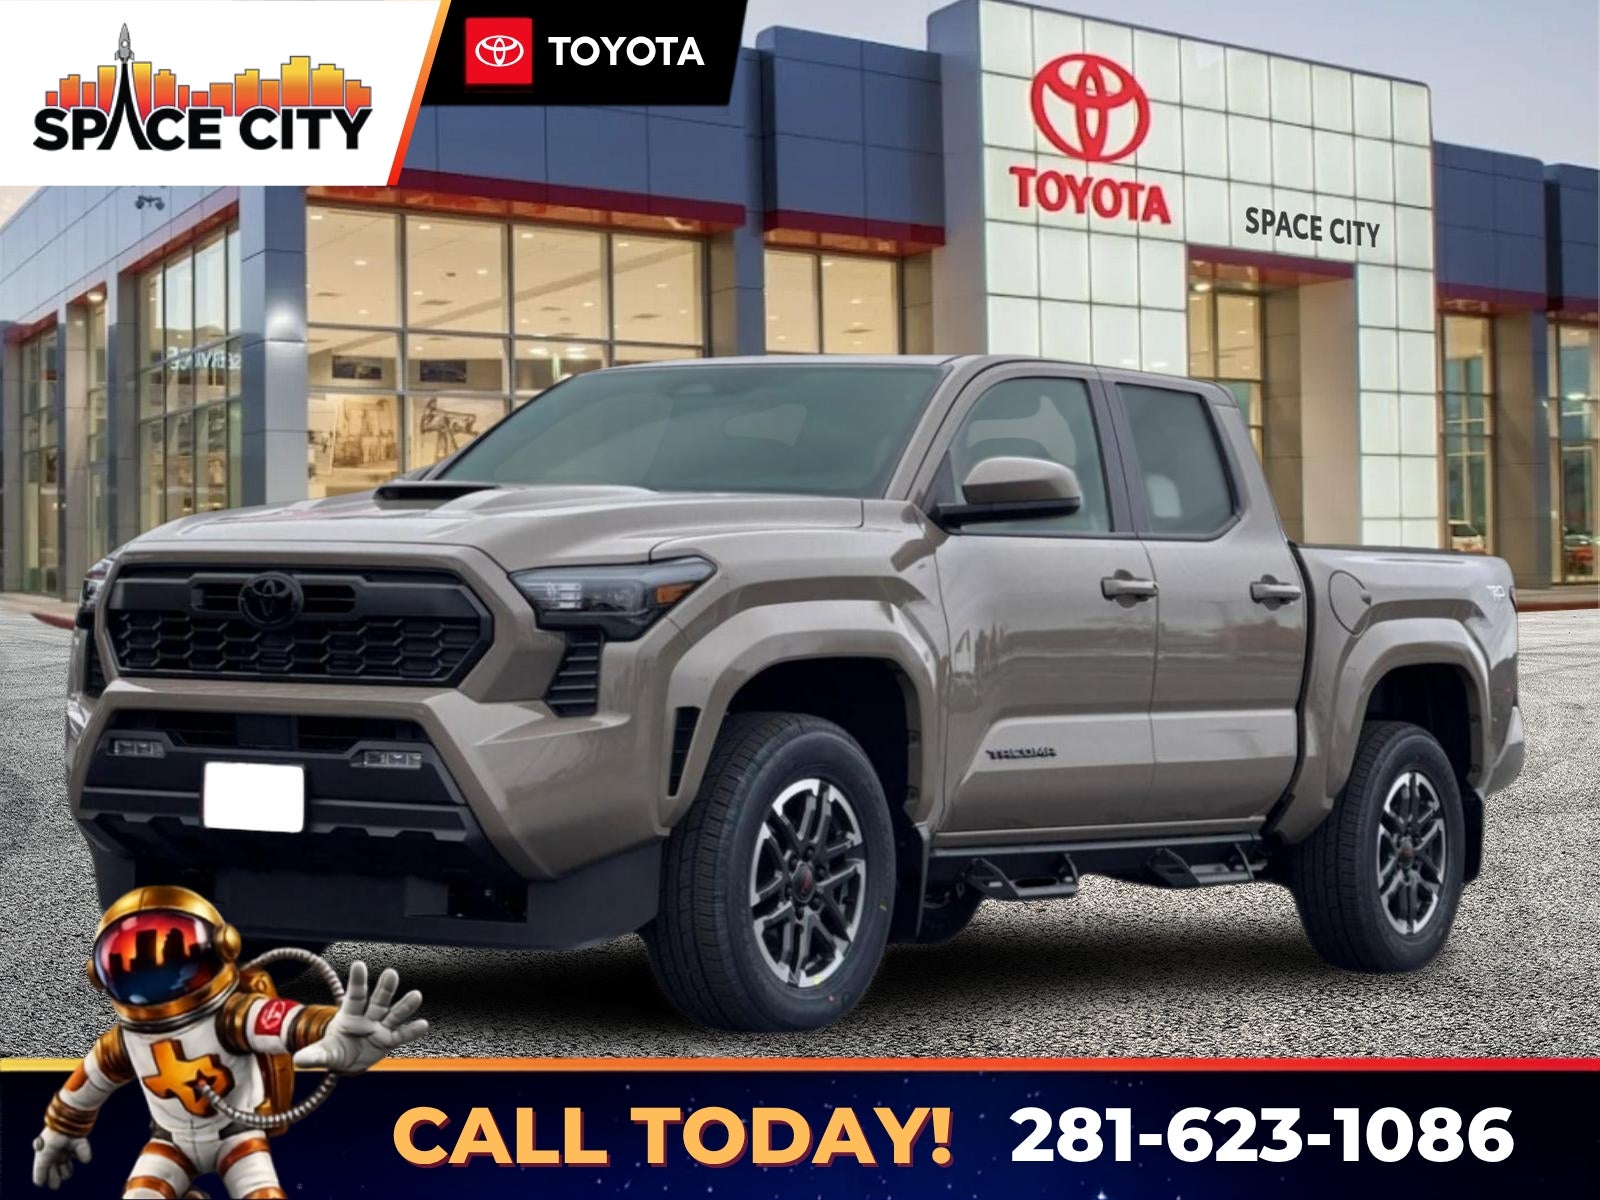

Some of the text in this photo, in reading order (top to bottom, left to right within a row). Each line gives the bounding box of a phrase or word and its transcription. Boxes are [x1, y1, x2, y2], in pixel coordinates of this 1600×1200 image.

[1009, 165, 1172, 225] TOYOTA
[1244, 206, 1381, 249] SPACE CITY
